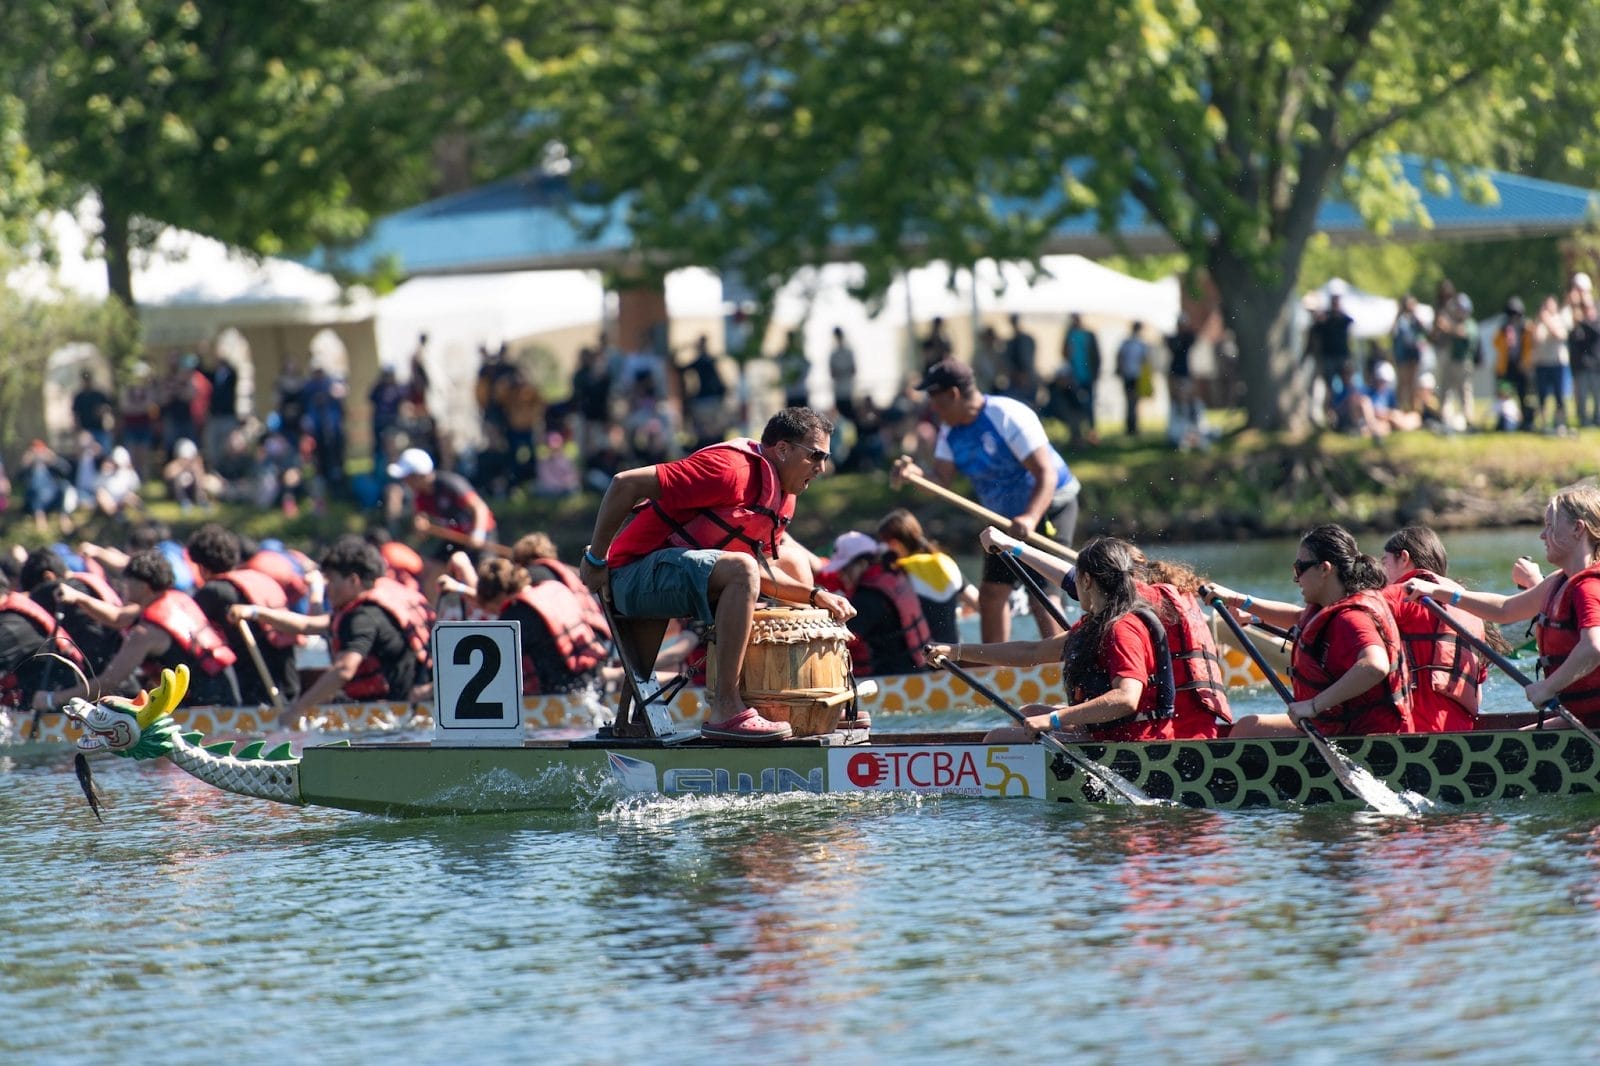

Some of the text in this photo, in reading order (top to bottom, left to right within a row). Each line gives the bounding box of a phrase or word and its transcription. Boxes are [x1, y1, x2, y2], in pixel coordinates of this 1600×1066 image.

[453, 634, 503, 719] 2
[663, 767, 824, 793] GWN
[885, 752, 982, 787] TCBA
